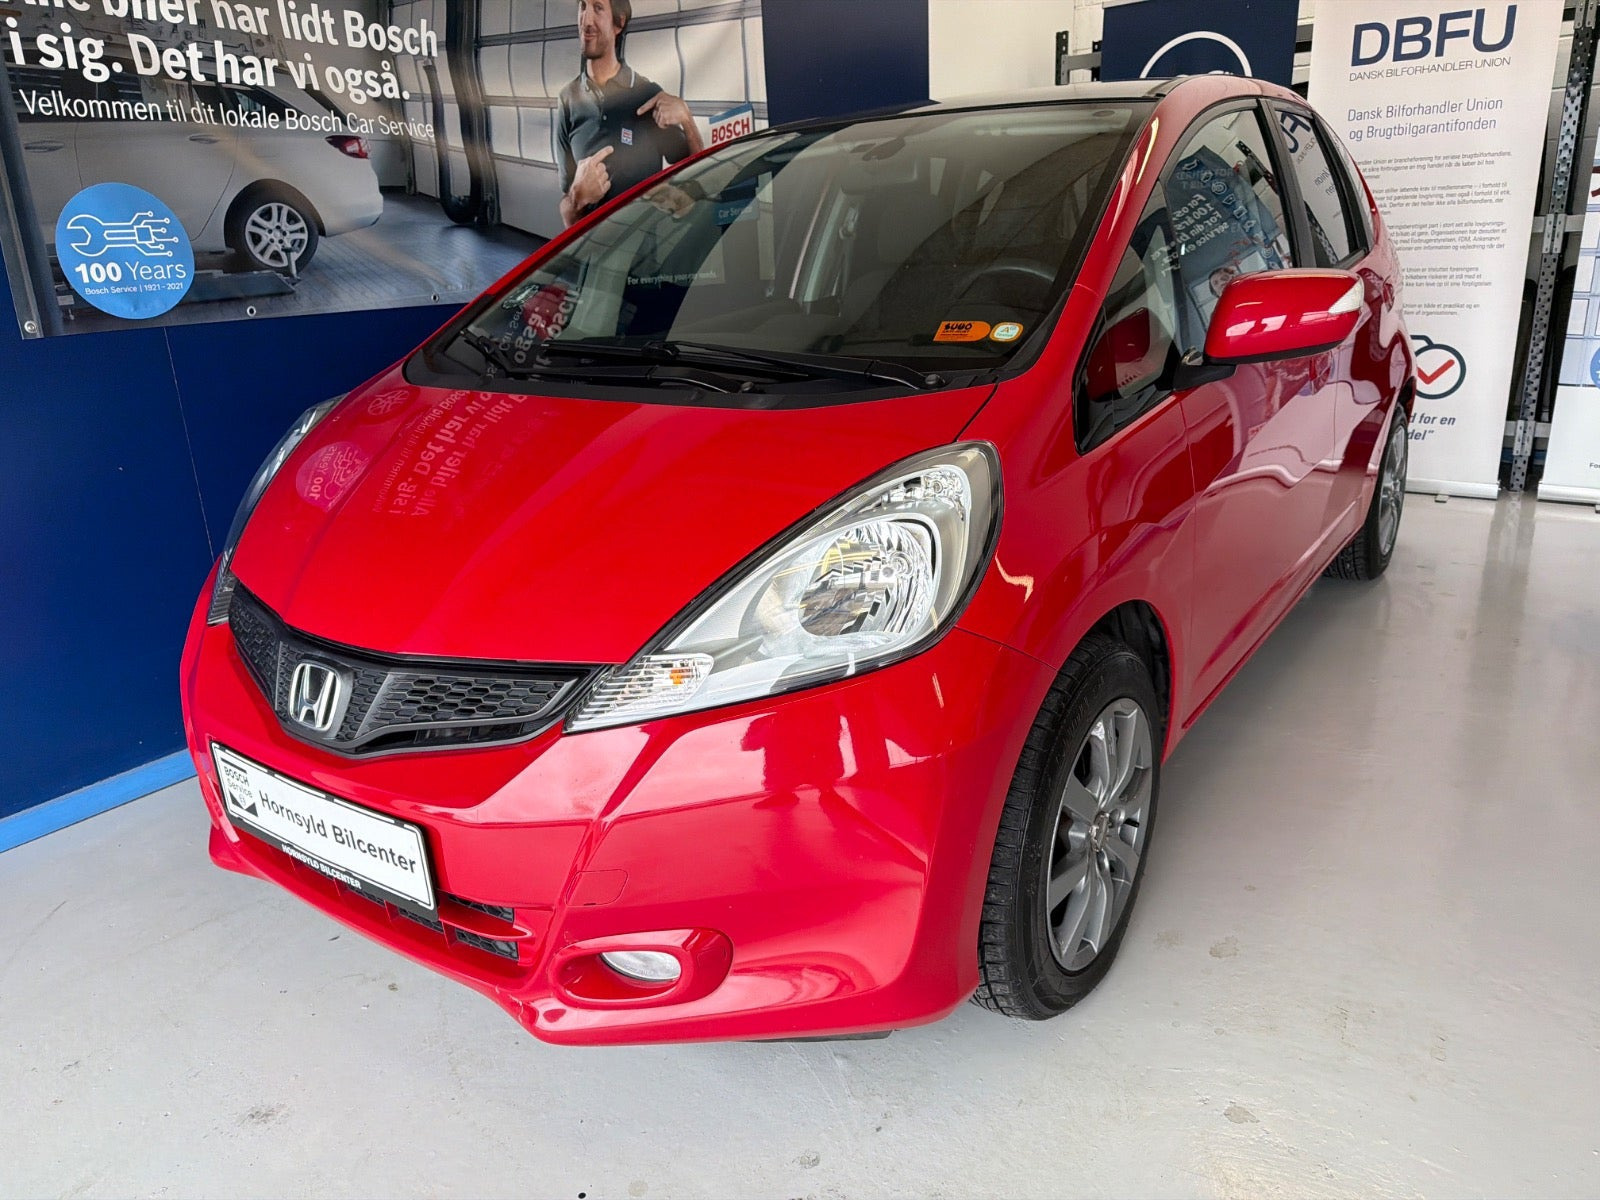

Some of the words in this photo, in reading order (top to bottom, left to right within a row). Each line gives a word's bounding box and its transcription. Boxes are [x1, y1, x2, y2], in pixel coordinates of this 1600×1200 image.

[211, 0, 269, 36] har
[277, 0, 339, 46] lidt
[343, 9, 438, 57] Bosch
[1351, 4, 1517, 67] DBFU
[5, 16, 26, 66] i
[36, 22, 123, 83] sig.
[127, 33, 206, 82] Det
[214, 40, 279, 87] har
[286, 52, 320, 91] vi
[325, 60, 410, 105] også.
[1349, 69, 1384, 82] DANSK
[1385, 60, 1474, 78] BILFORHANDLER
[1475, 57, 1511, 70] UNION
[19, 89, 161, 122] Velkommen
[166, 98, 188, 124] til
[191, 102, 217, 126] dit
[220, 103, 280, 130] lokale
[284, 107, 343, 133] Bosch
[347, 112, 375, 135] Car
[379, 115, 435, 138] Service
[1348, 108, 1382, 122] Dansk
[1386, 101, 1463, 119] Bilforhandler
[1466, 98, 1503, 112] Union
[711, 117, 750, 144] BOSCH
[1349, 129, 1363, 142] og
[1366, 117, 1496, 141] Brugtbilgarantifonden
[75, 261, 122, 284] 100
[125, 260, 187, 281] Years
[85, 287, 109, 295] Bosch
[111, 285, 138, 294] Service
[144, 284, 161, 292] 1921
[167, 282, 183, 291] 2021
[1419, 412, 1437, 424] for
[1440, 415, 1456, 425] en
[258, 790, 328, 840] Hornsyld
[331, 825, 416, 874] Bilcenter
[281, 843, 320, 869] HORNSYLD
[319, 863, 362, 890] BILCENTER
